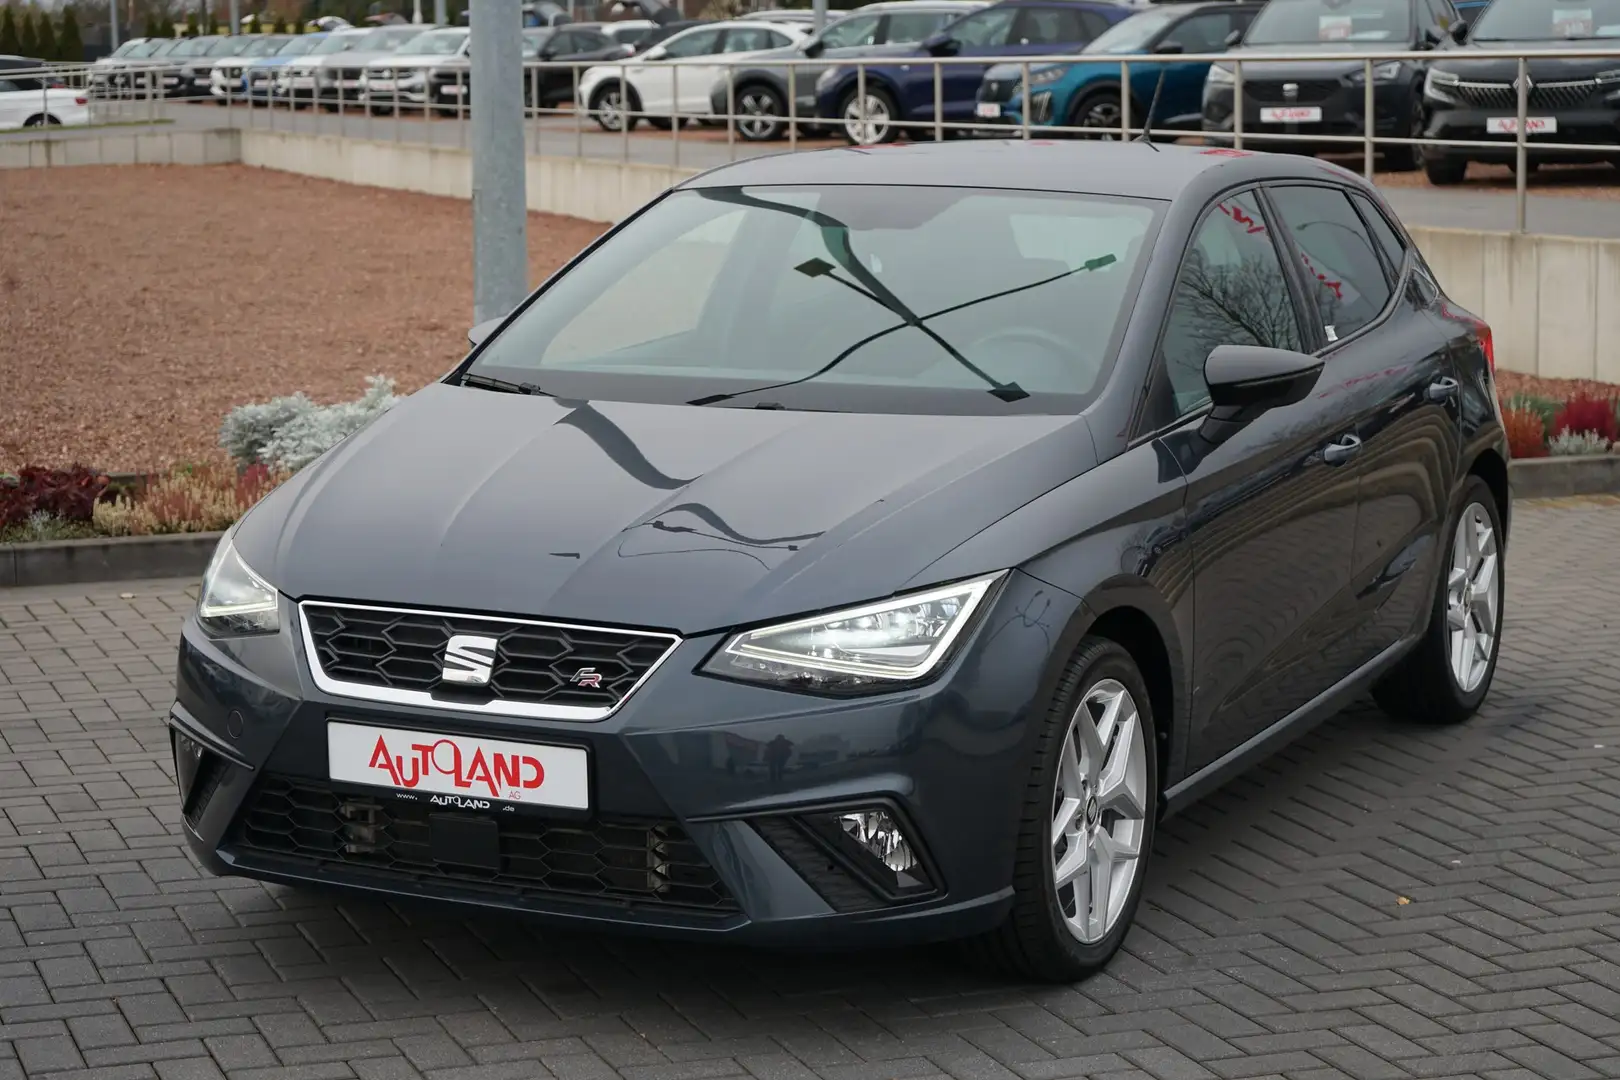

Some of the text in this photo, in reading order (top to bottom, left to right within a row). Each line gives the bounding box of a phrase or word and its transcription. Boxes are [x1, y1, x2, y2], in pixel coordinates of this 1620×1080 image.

[569, 667, 603, 689] FR
[368, 734, 546, 798] AUTOLAND
[396, 792, 418, 800] www.
[429, 794, 491, 809] AUTOLAND
